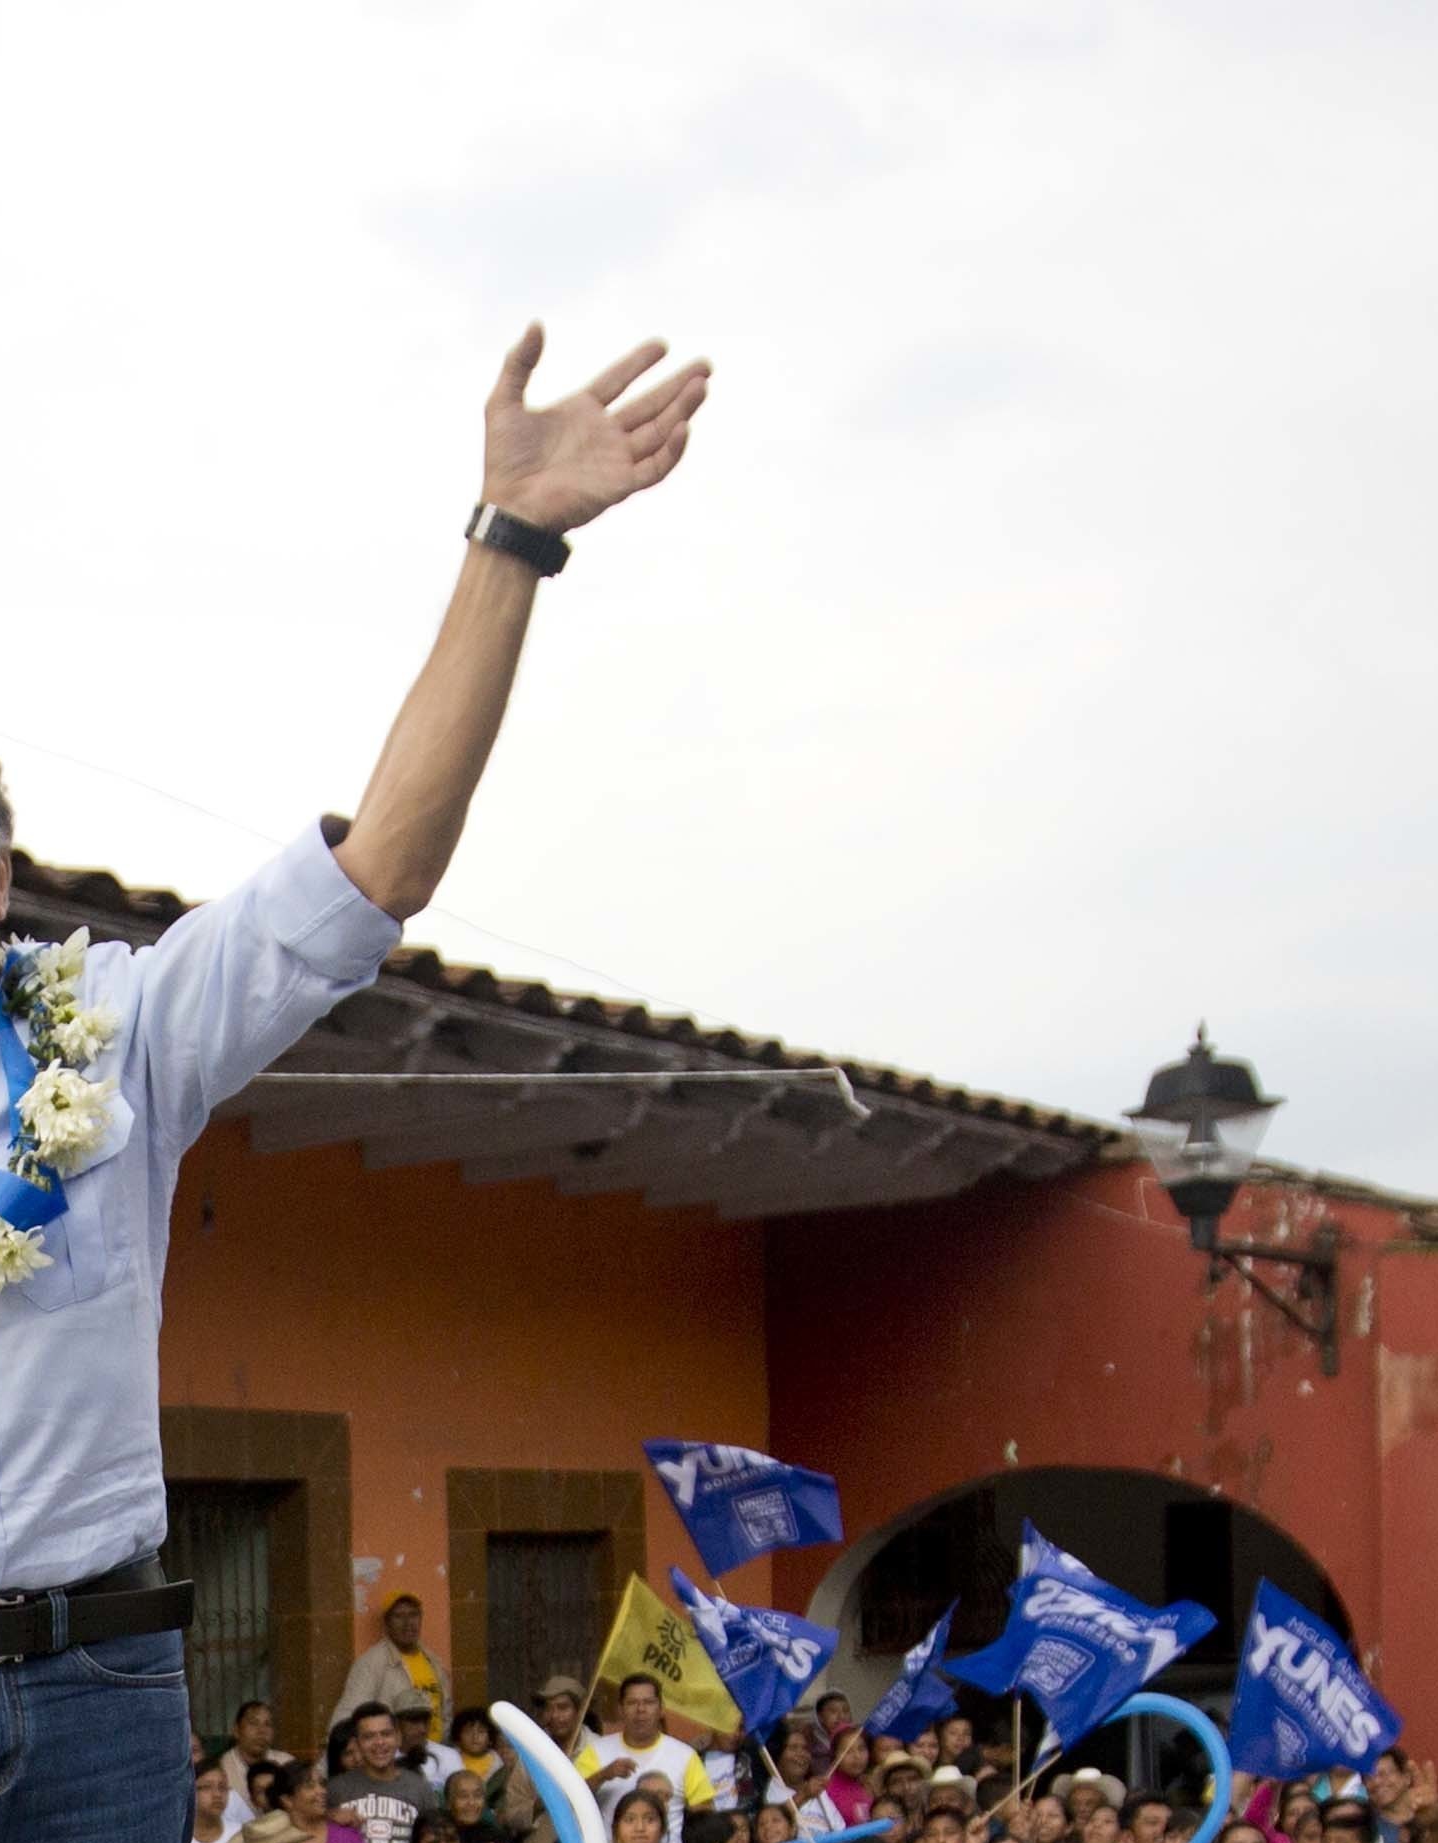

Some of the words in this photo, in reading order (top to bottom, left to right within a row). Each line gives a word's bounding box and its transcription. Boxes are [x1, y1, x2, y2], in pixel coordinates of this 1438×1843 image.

[1286, 1616, 1336, 1660] MIGUEL
[643, 1644, 682, 1682] PRD
[1250, 1613, 1382, 1758] YUNES
